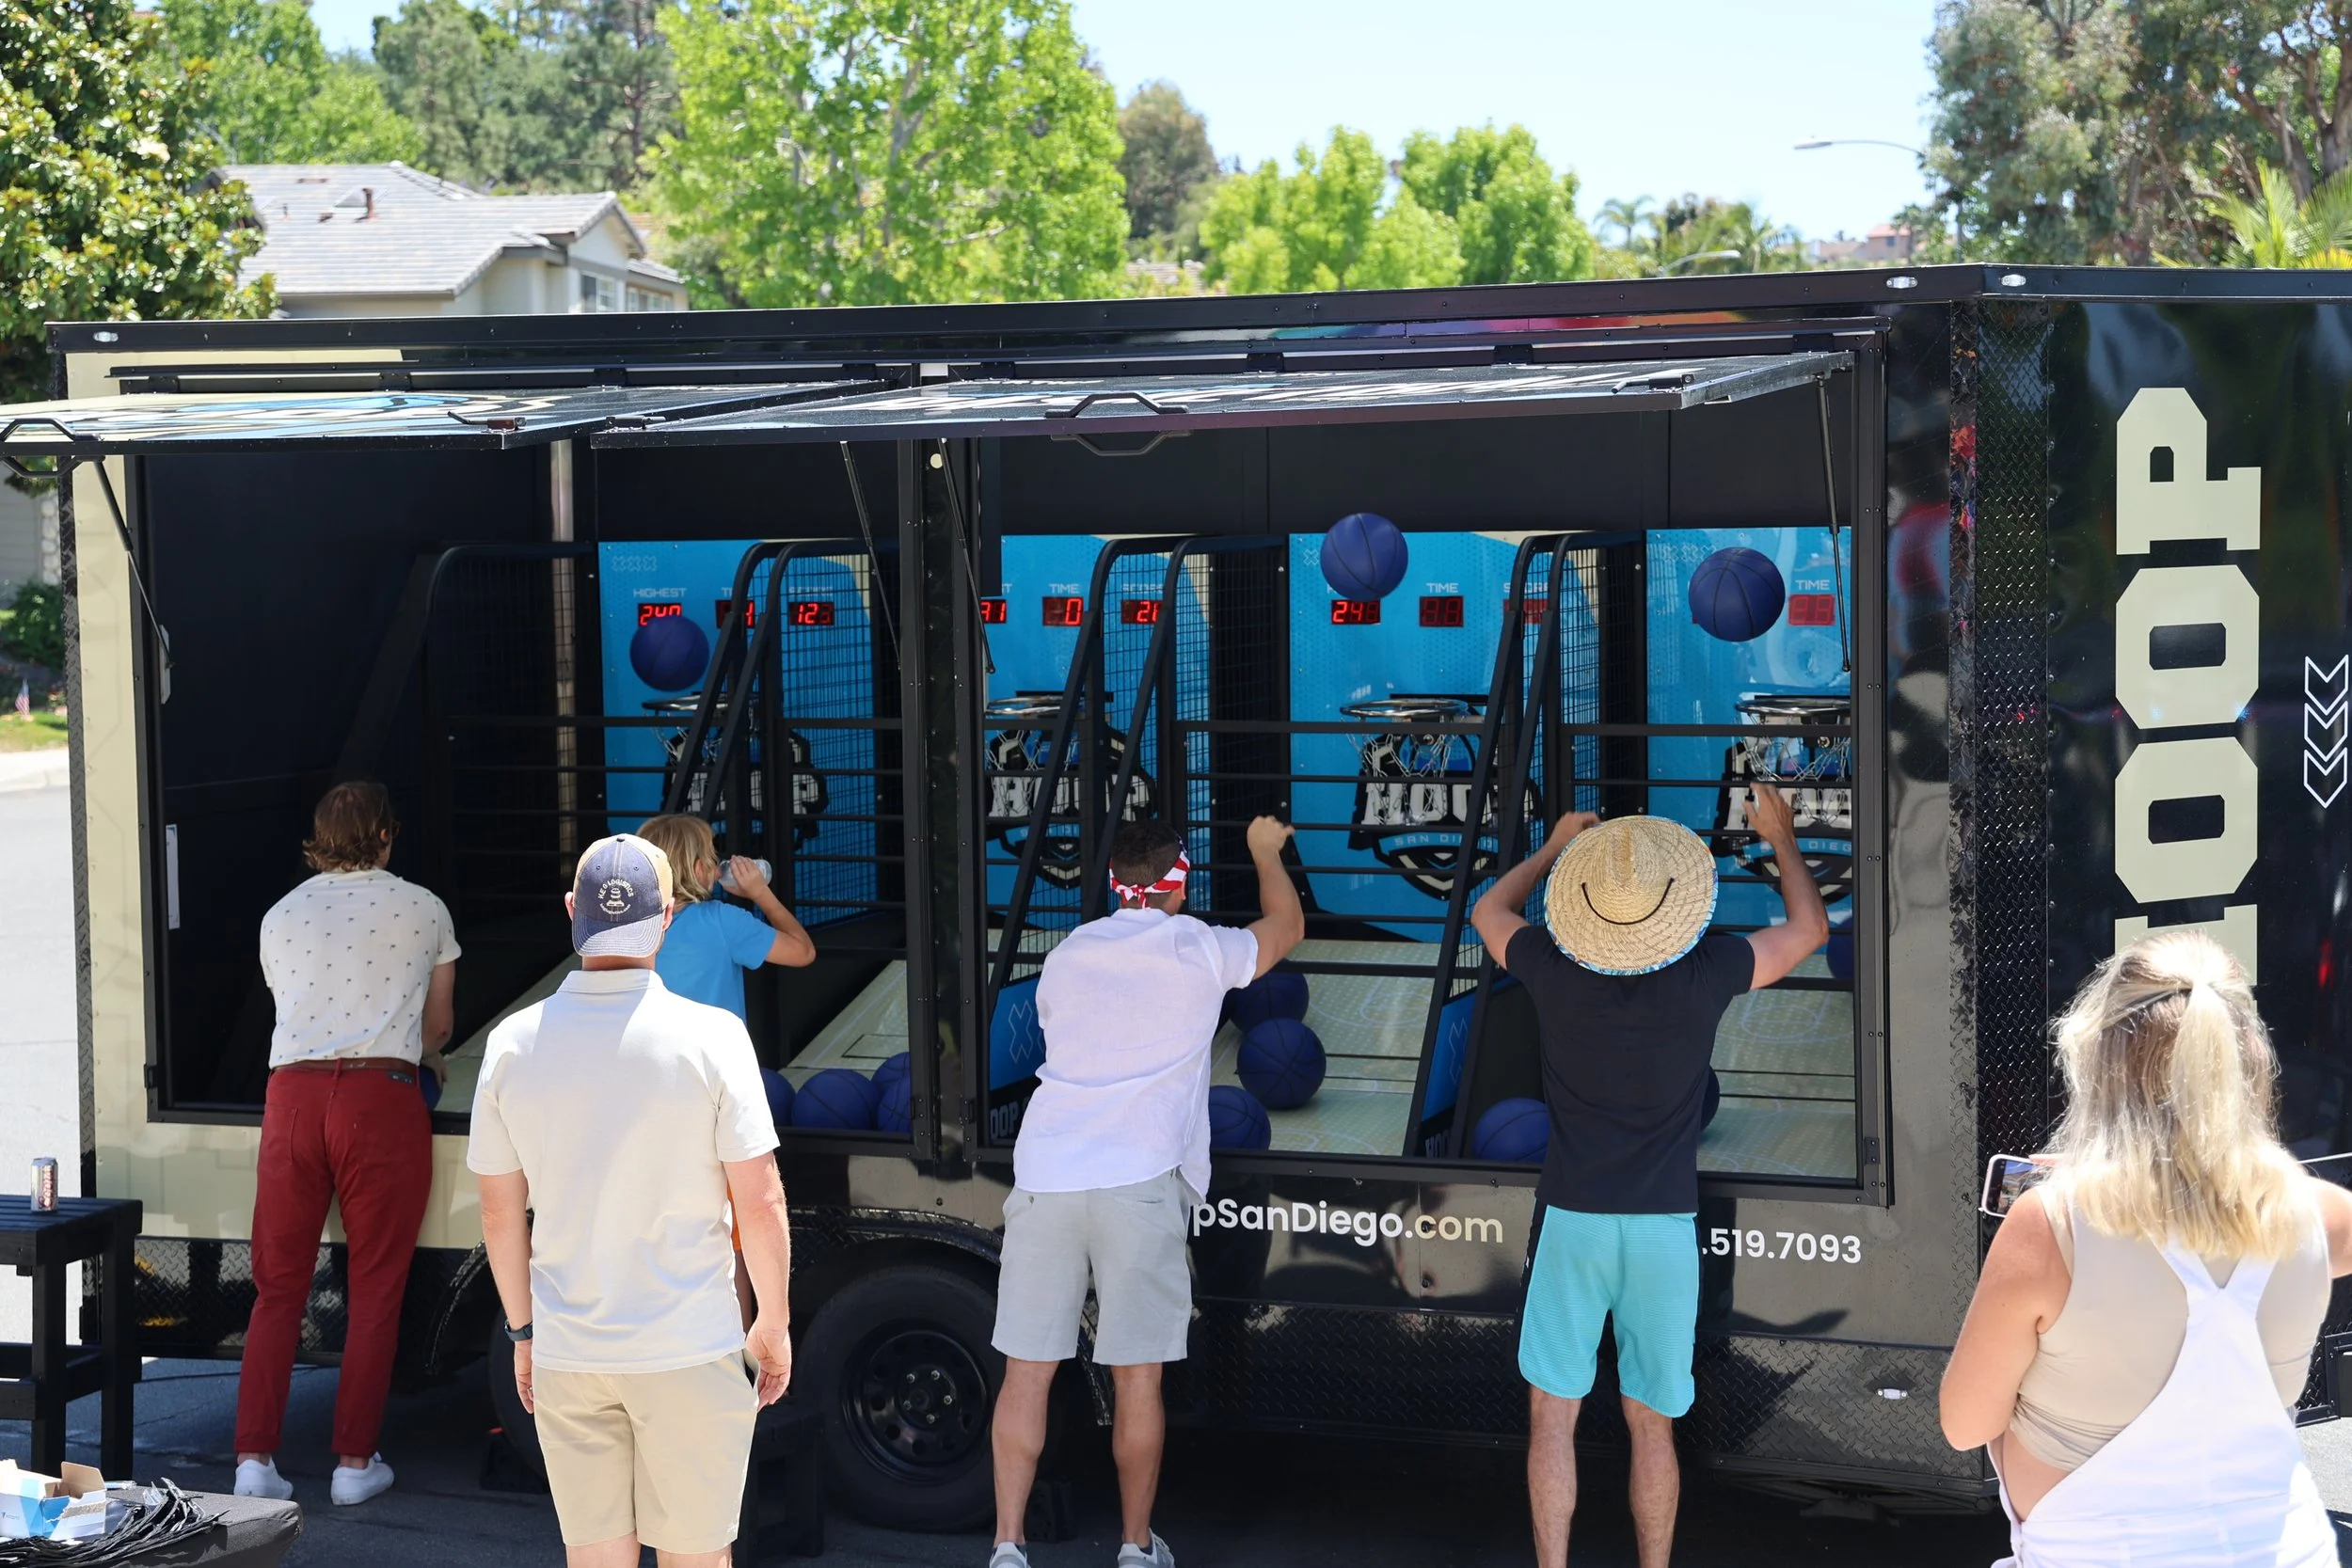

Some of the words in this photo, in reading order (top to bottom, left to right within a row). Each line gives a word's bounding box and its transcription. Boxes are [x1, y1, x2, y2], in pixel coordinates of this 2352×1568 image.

[1048, 583, 1081, 594] TIME
[1426, 583, 1459, 594] TIME
[1795, 579, 1831, 591] TIME
[632, 587, 687, 598] HIGHEST
[1394, 834, 1429, 846] SAN
[1808, 840, 1851, 852] DIEG
[607, 879, 634, 897] LOGISTICS
[1193, 1198, 1503, 1247] pSanDiego.com
